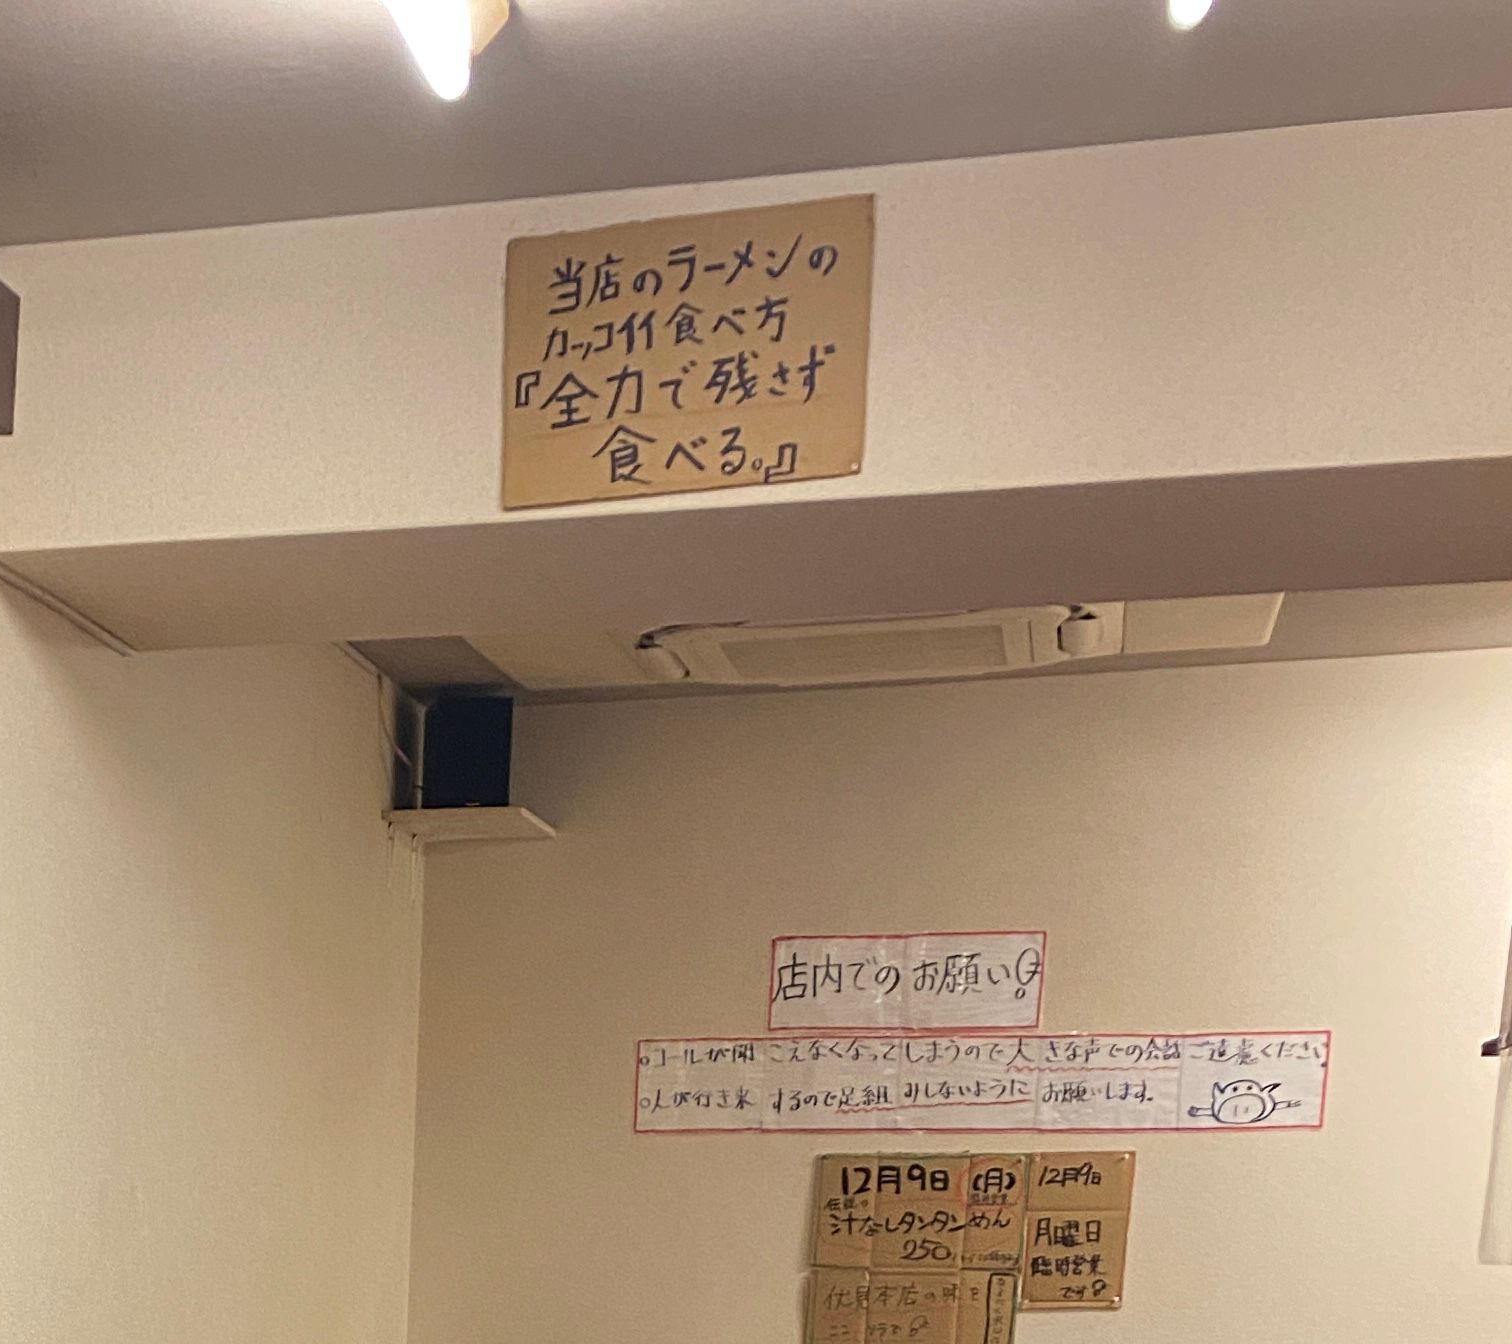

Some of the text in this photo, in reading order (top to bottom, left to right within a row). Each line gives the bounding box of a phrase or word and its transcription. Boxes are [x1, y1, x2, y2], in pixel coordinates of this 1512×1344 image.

[548, 233, 838, 315] 当店のラーメンの
[543, 296, 788, 362] カッコイイ食べ方
[515, 344, 836, 430] 『全力で残さず
[1035, 1217, 1101, 1247] 月曜日
